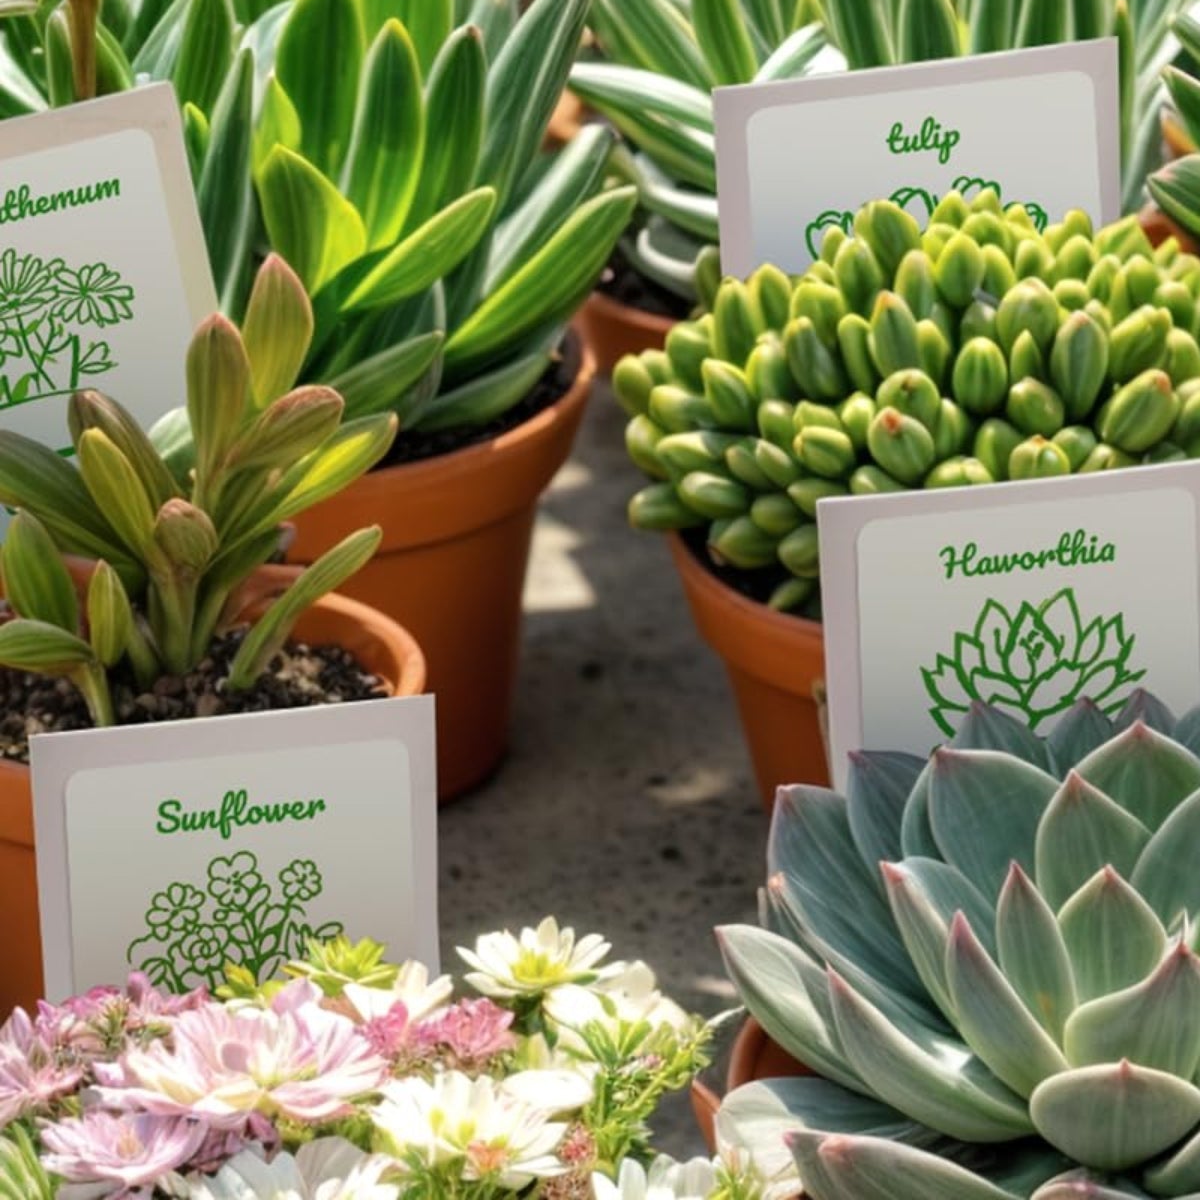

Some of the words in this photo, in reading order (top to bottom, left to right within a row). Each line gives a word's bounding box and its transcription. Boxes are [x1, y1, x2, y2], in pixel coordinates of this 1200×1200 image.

[885, 115, 960, 165] tulip
[939, 528, 1116, 580] Haworthia
[156, 788, 327, 841] Sunflower
